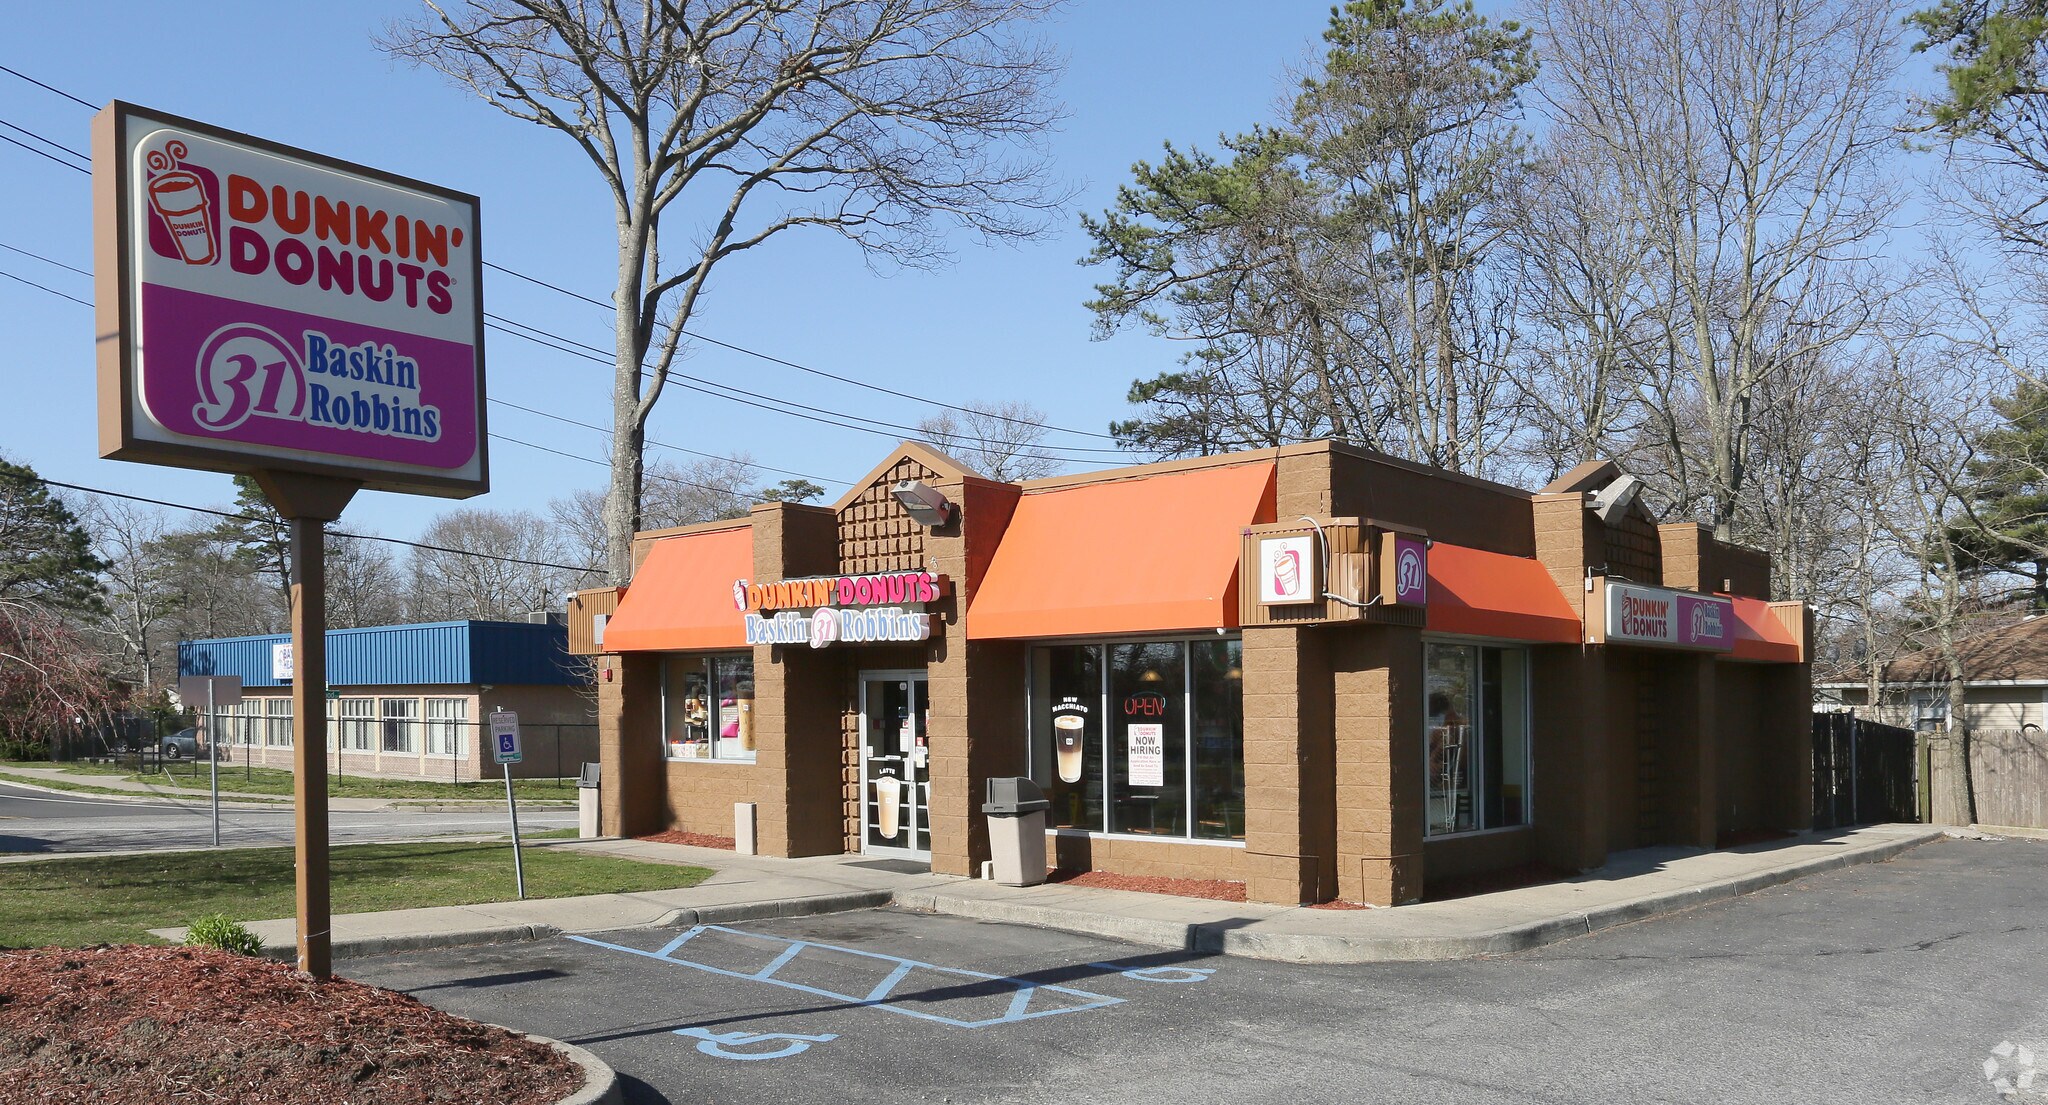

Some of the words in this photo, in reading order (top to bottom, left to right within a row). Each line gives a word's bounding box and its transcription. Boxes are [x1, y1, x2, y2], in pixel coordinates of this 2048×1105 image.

[173, 220, 203, 230] DUNKIN
[227, 173, 464, 268] DUNKIN'
[176, 227, 206, 237] DONUTS
[229, 226, 453, 315] DONUTS
[306, 333, 417, 390] Baskin
[197, 353, 287, 426] 31
[308, 382, 438, 438] Robbins
[1399, 561, 1417, 594] 31
[748, 579, 836, 611] DUNKIN'
[838, 572, 934, 605] DONUTS
[1632, 597, 1669, 618] DUNKIN'
[745, 613, 807, 644] Baskin
[841, 609, 922, 642] Robbins
[1633, 618, 1668, 638] DONUTS
[1052, 703, 1089, 713] MACCHIATO
[1124, 698, 1163, 716] OPEN
[493, 716, 515, 724] RESERVED
[495, 725, 516, 733] PARKING
[1130, 746, 1161, 755] HIRING
[1135, 736, 1156, 745] NOW
